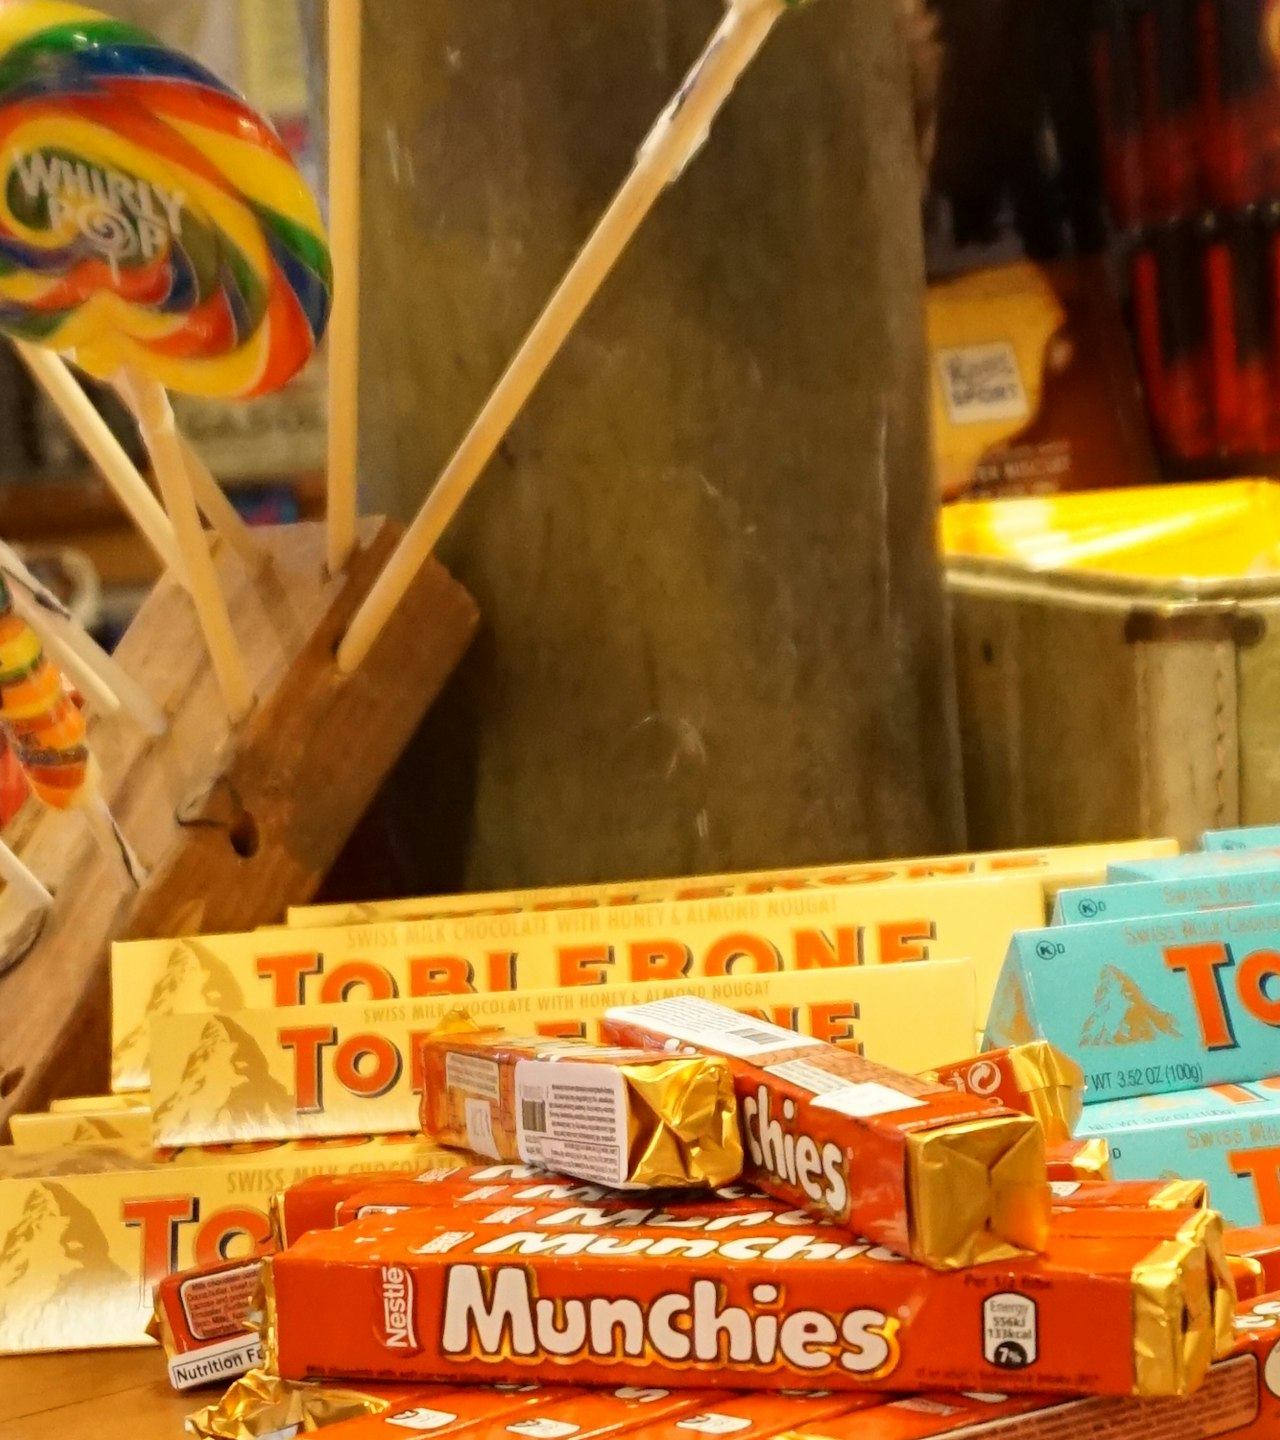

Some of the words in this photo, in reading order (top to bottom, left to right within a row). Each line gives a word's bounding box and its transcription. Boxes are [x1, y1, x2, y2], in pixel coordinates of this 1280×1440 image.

[13, 145, 187, 238] WHIRLY
[347, 926, 395, 950] SWISS
[402, 921, 448, 946] MILK
[451, 912, 553, 944] CHOCOLATE
[557, 907, 598, 935] WITH
[603, 903, 666, 931] HONEY
[682, 897, 758, 926] ALMOND
[760, 893, 838, 920] NOUGAT
[363, 1004, 405, 1024] SWISS
[536, 992, 572, 1012] WITH
[579, 988, 630, 1010] HONEY
[709, 980, 771, 999] NOUGAT
[745, 1084, 847, 1211] chies
[442, 1264, 890, 1370] Munchies
[175, 1345, 244, 1386] Nutrition
